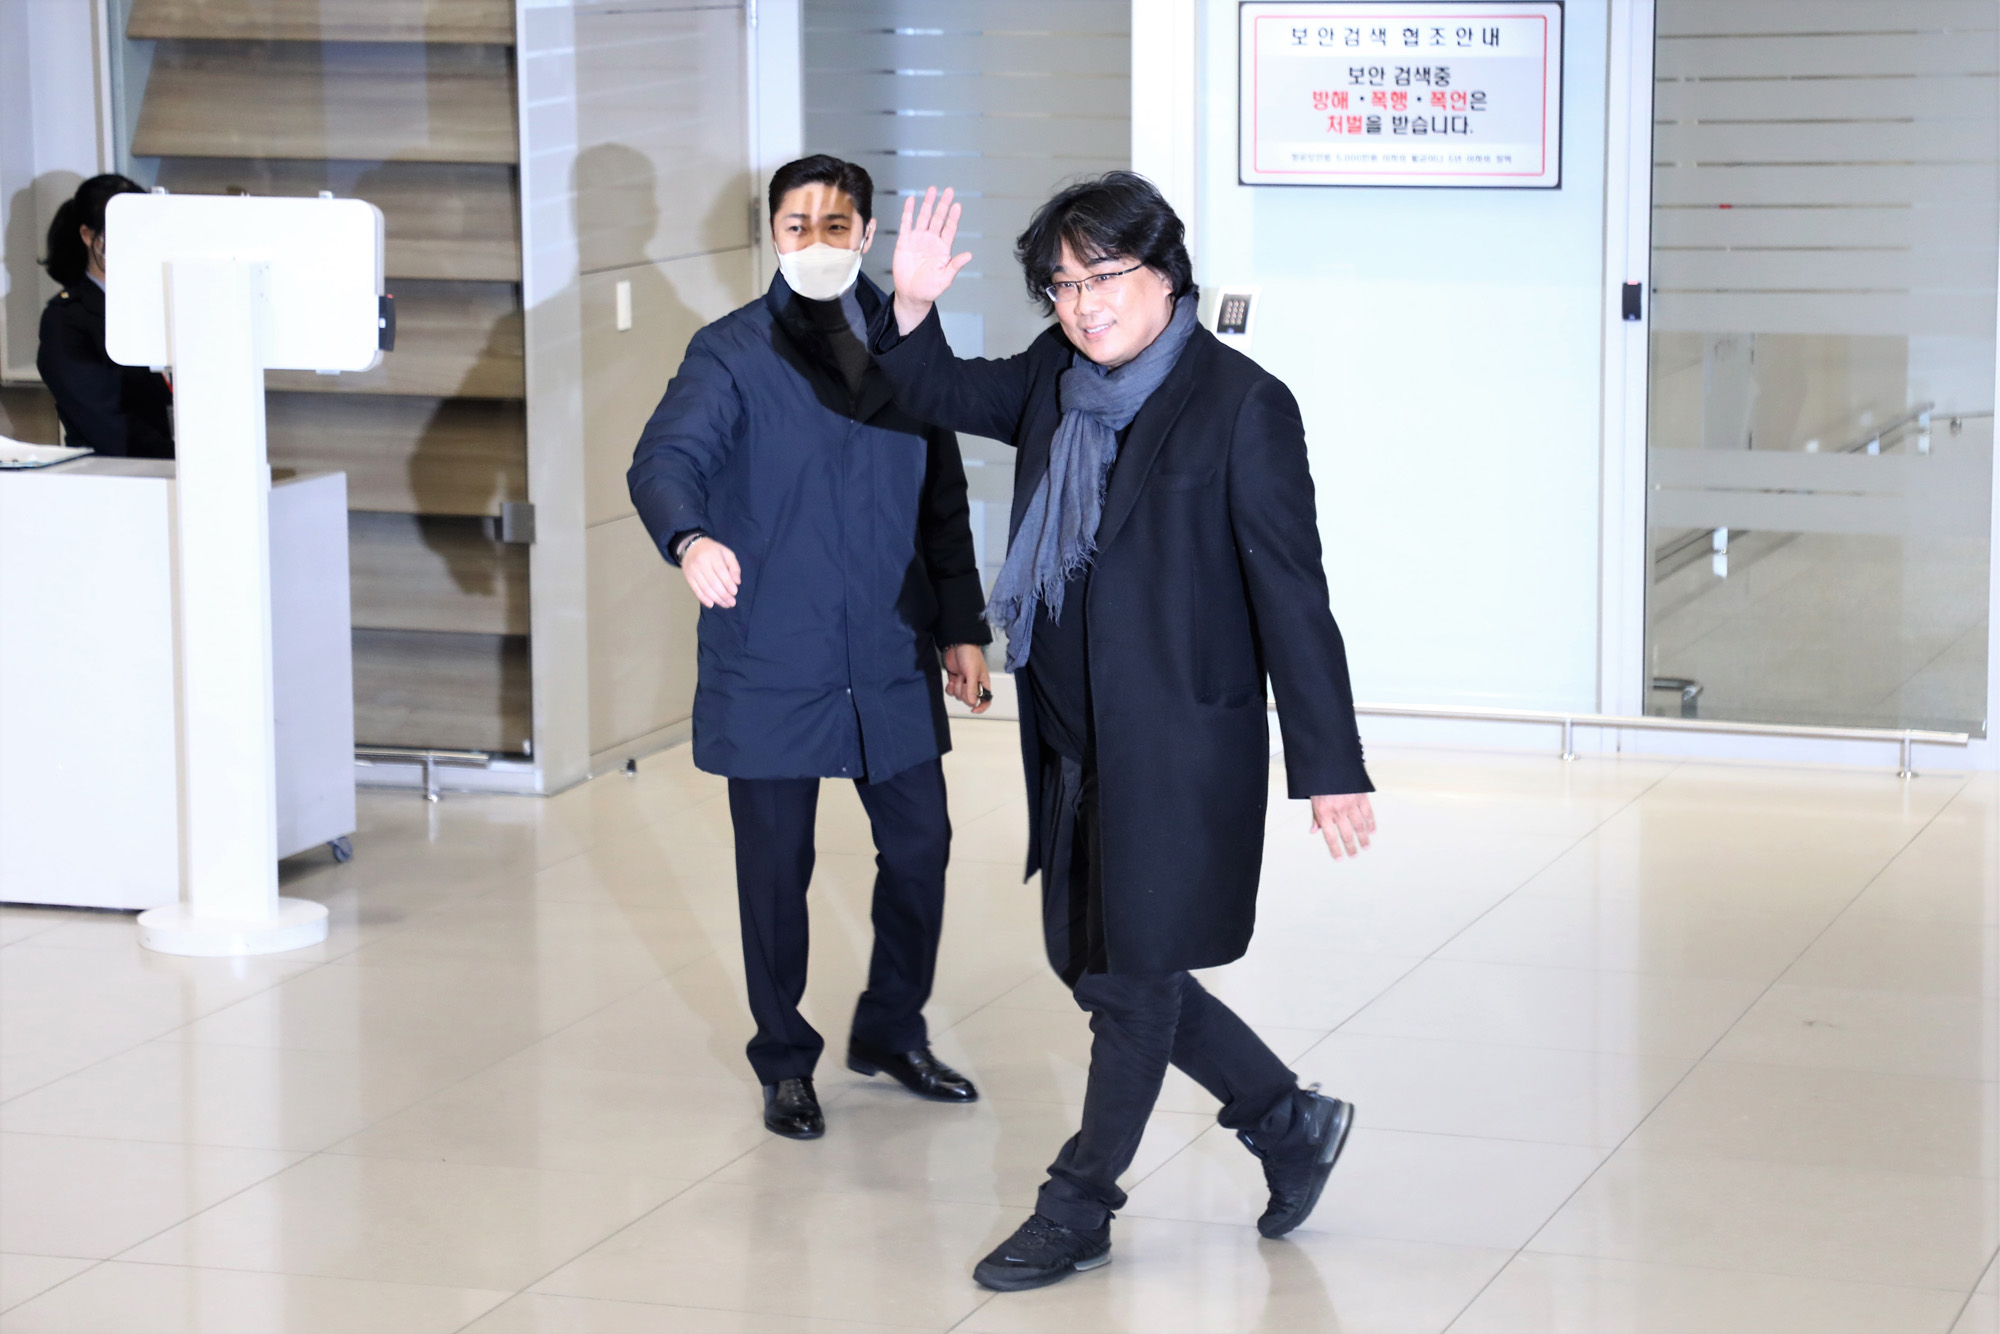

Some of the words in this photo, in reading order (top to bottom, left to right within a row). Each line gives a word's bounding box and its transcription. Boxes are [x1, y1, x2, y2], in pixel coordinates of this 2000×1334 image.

[1291, 27, 1387, 47] 보안검색
[1348, 66, 1385, 86] 보안
[1394, 66, 1451, 87] 검색중
[1313, 91, 1349, 111] 방해
[1371, 91, 1408, 111] 폭행
[1430, 91, 1487, 111] 폭언은
[1327, 115, 1382, 135] 처벌을
[1392, 115, 1474, 135] 받습니다.
